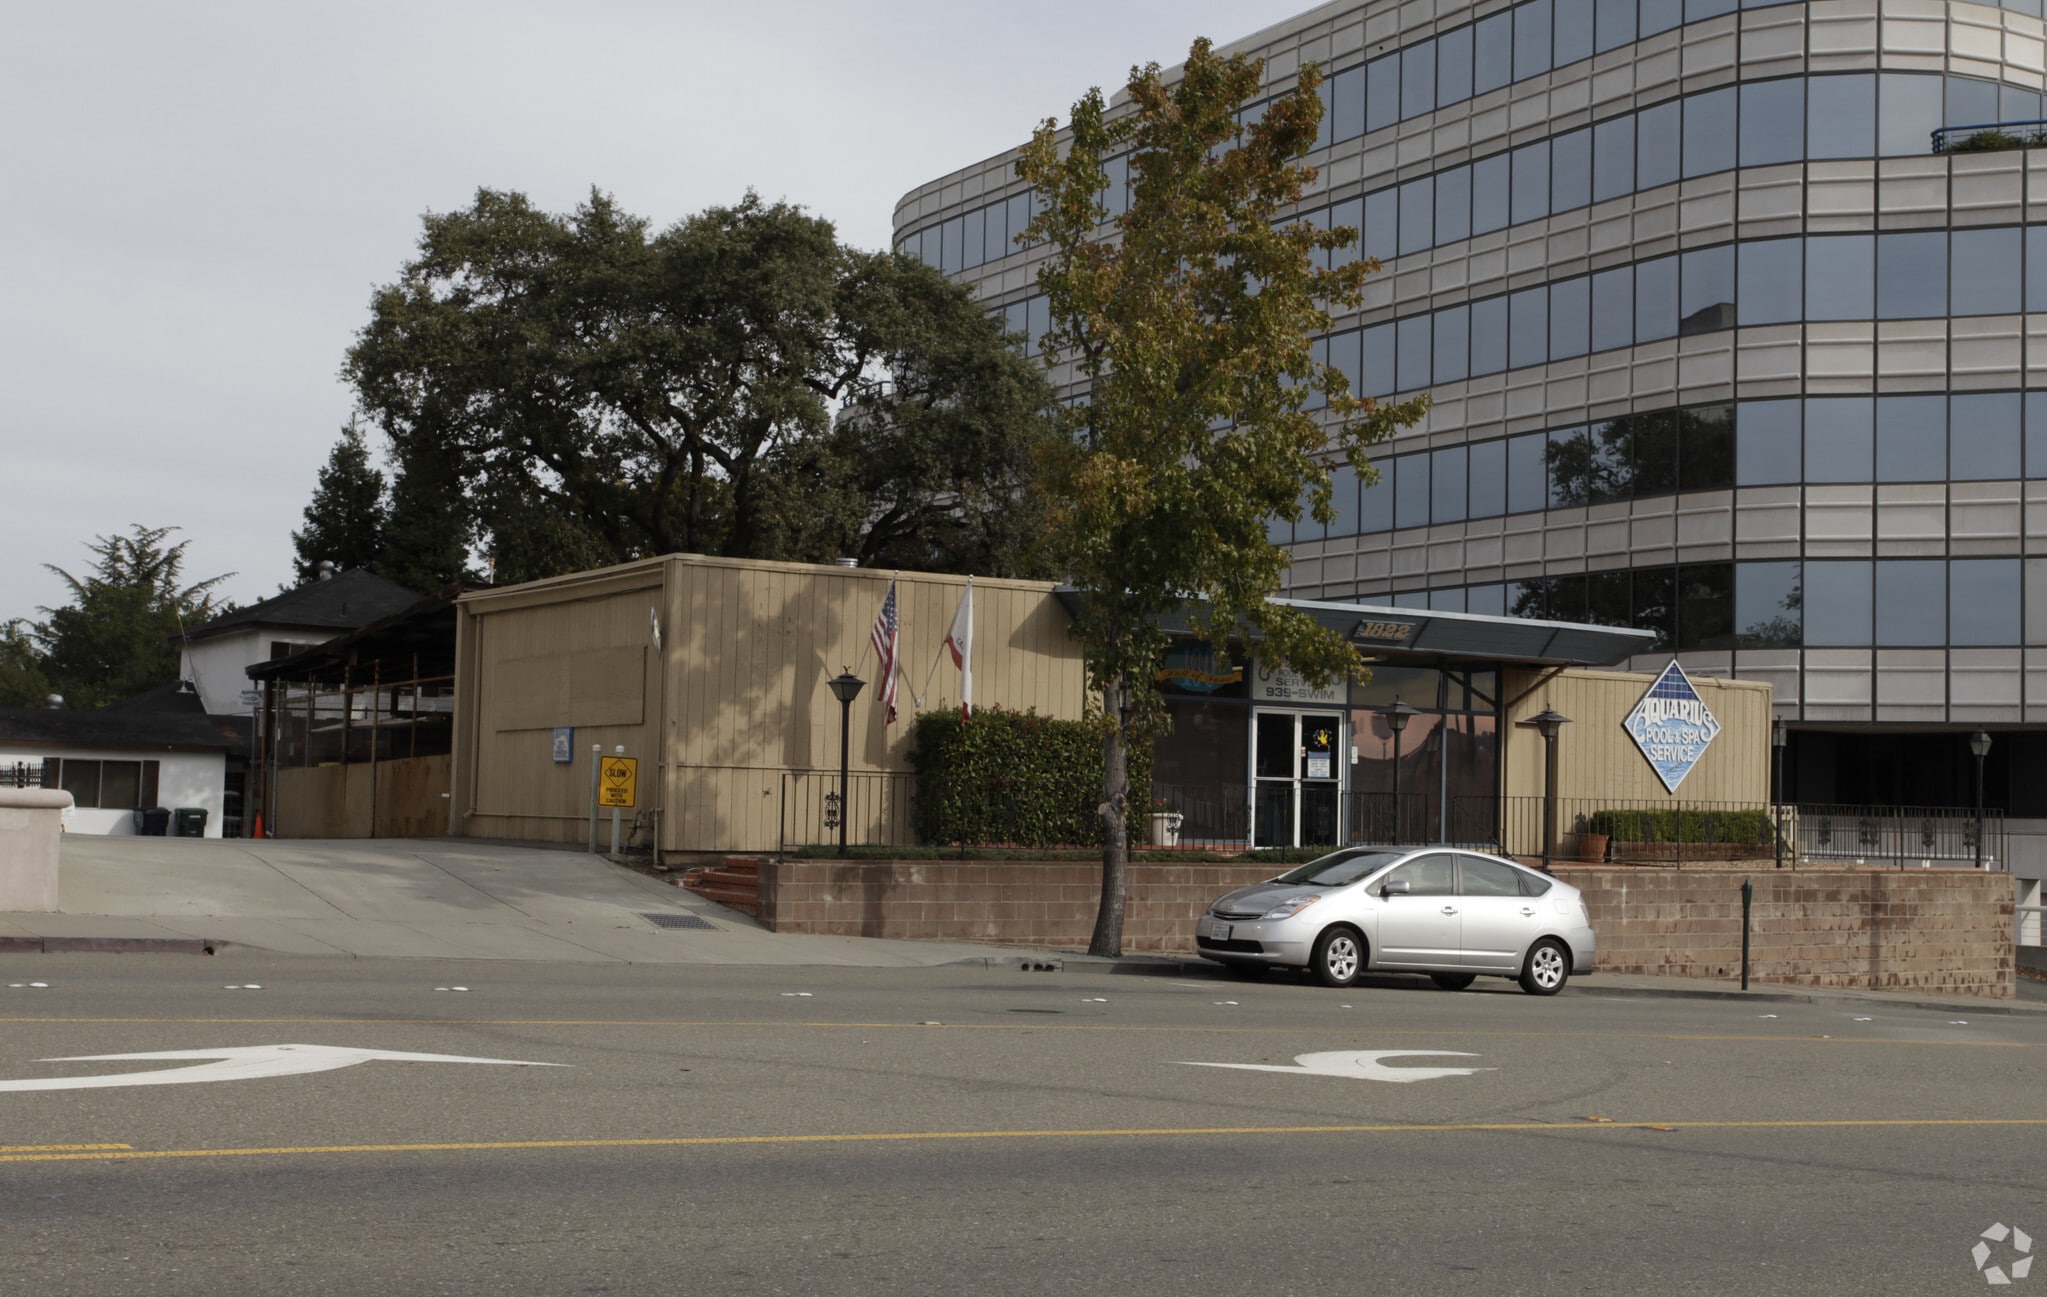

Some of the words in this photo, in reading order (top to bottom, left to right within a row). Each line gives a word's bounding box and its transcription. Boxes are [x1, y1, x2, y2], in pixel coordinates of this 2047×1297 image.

[1360, 623, 1409, 639] 1822
[1275, 678, 1315, 687] SERV
[1266, 687, 1335, 700] 939-SWIM
[1633, 698, 1714, 743] AQUARIUS
[1646, 728, 1671, 744] POOL
[1673, 732, 1680, 743] &
[1682, 728, 1701, 744] SPA
[1650, 745, 1695, 762] SERVICE
[609, 768, 628, 778] SLOW
